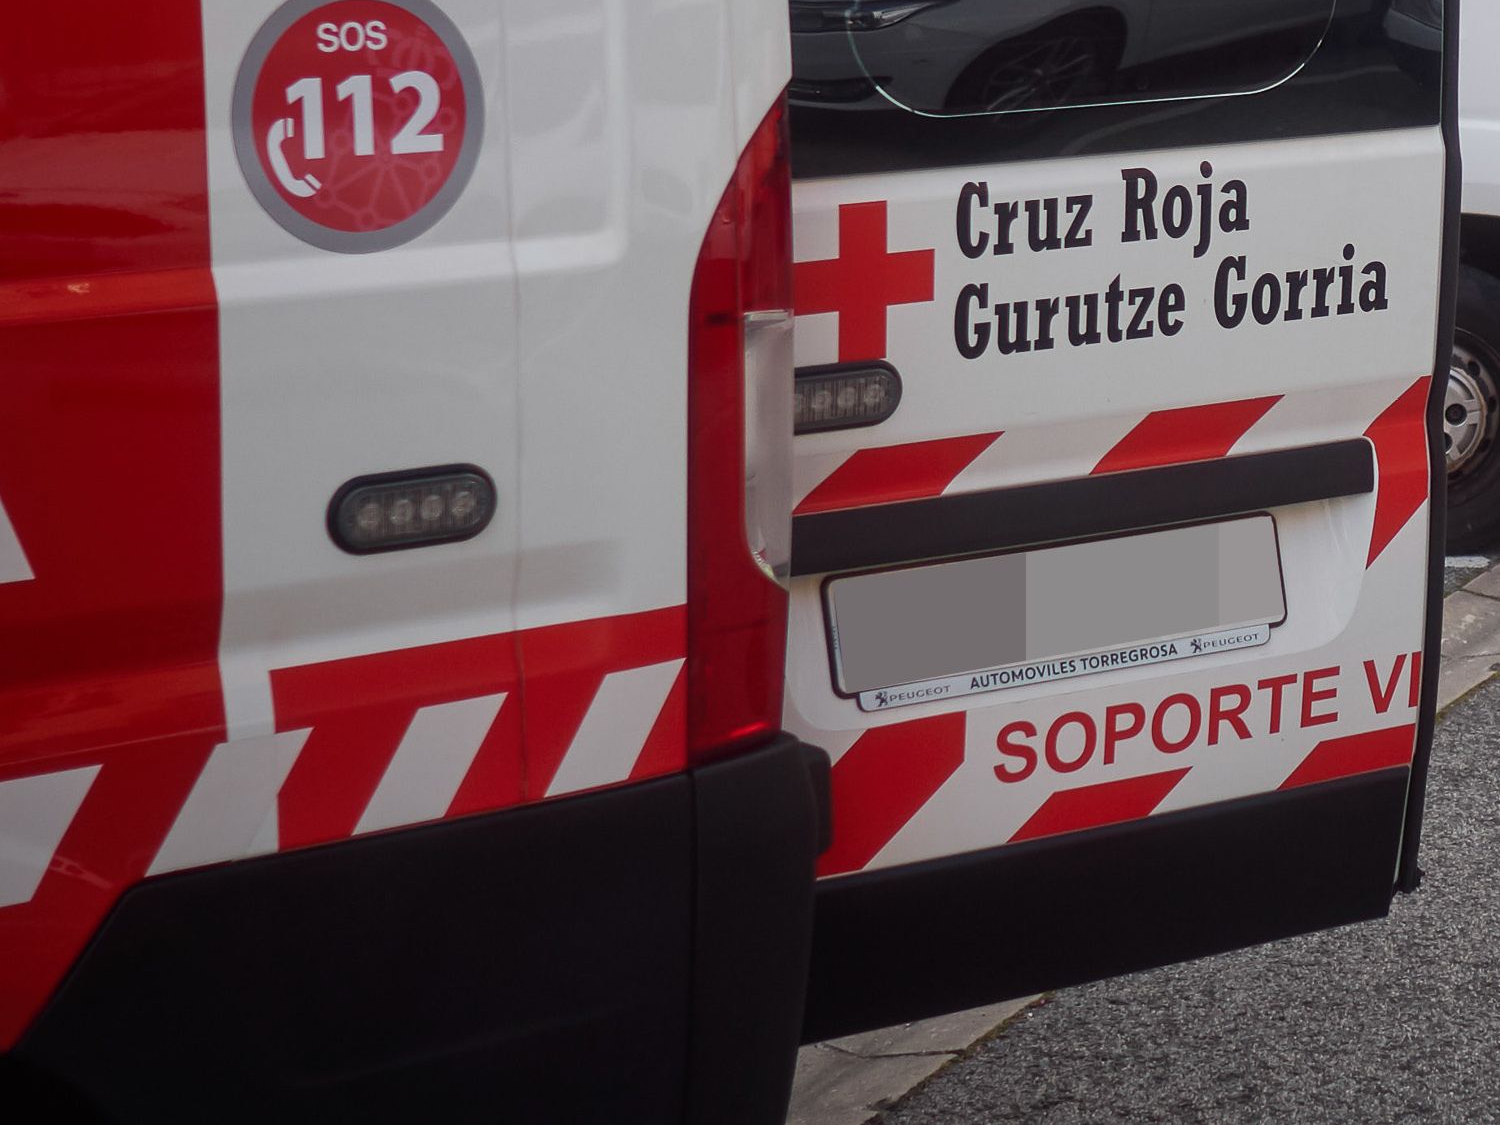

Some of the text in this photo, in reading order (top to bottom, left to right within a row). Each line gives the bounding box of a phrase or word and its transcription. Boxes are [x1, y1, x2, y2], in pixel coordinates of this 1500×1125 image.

[316, 20, 388, 53] SOS
[285, 70, 444, 160] 112
[956, 160, 1250, 259] Cruz Roja
[953, 243, 1388, 360] Gurutze Gorria
[889, 632, 1260, 702] PEUGEOT AUTOMOVILES TORREGROSA PEUGEOT
[993, 651, 1422, 784] SOPORTE VI
